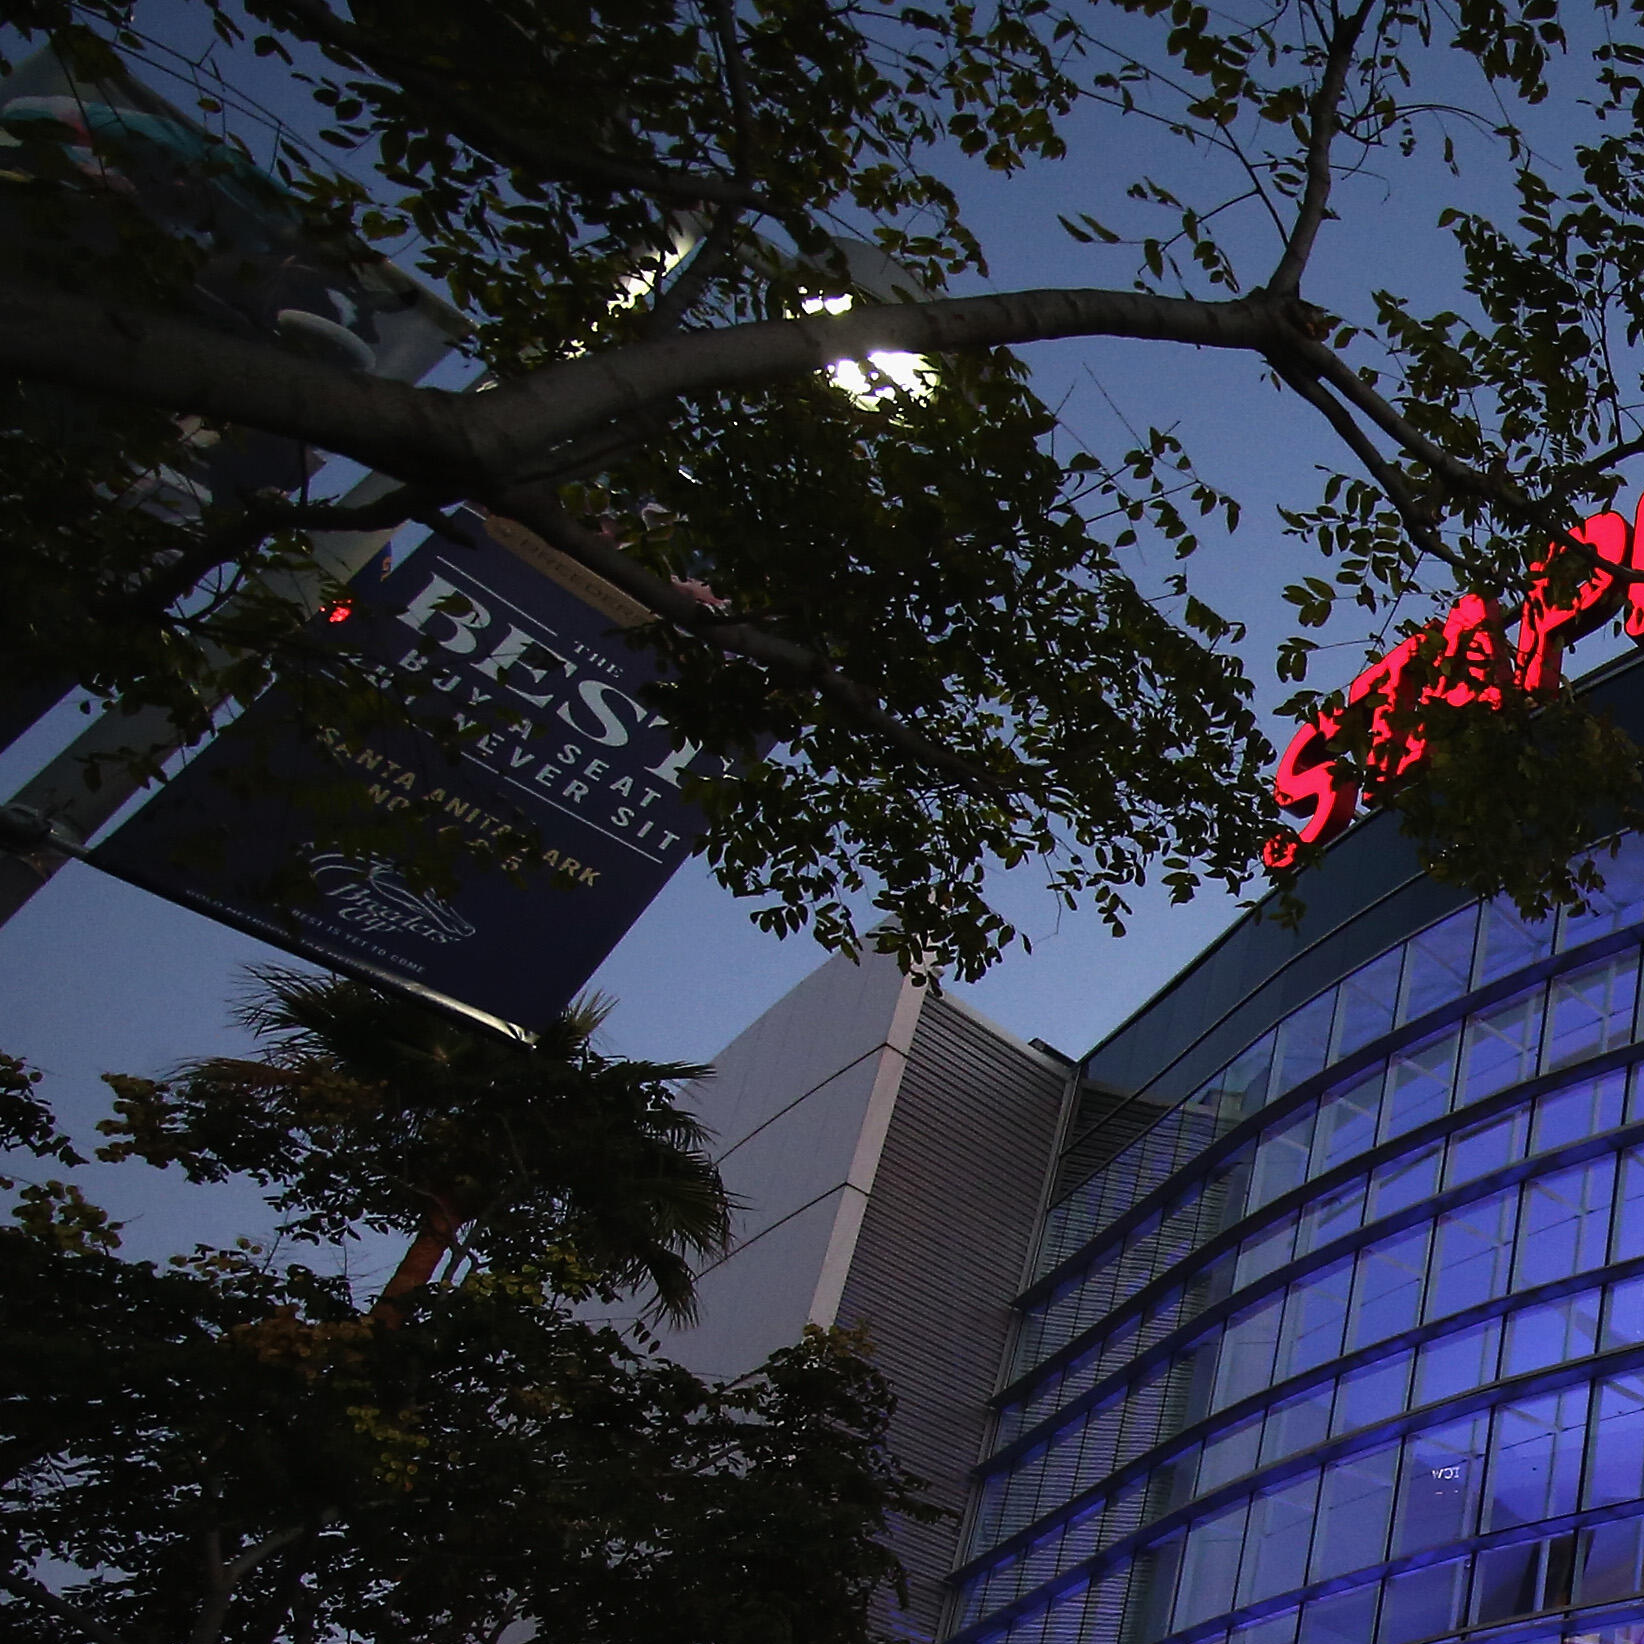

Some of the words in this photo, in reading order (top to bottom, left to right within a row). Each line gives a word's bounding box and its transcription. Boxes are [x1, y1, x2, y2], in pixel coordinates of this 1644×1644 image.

[574, 640, 624, 679] THE
[451, 711, 590, 805] NEVER
[610, 805, 681, 852] SIT
[556, 742, 662, 809] SEAT
[389, 953, 426, 975] COME
